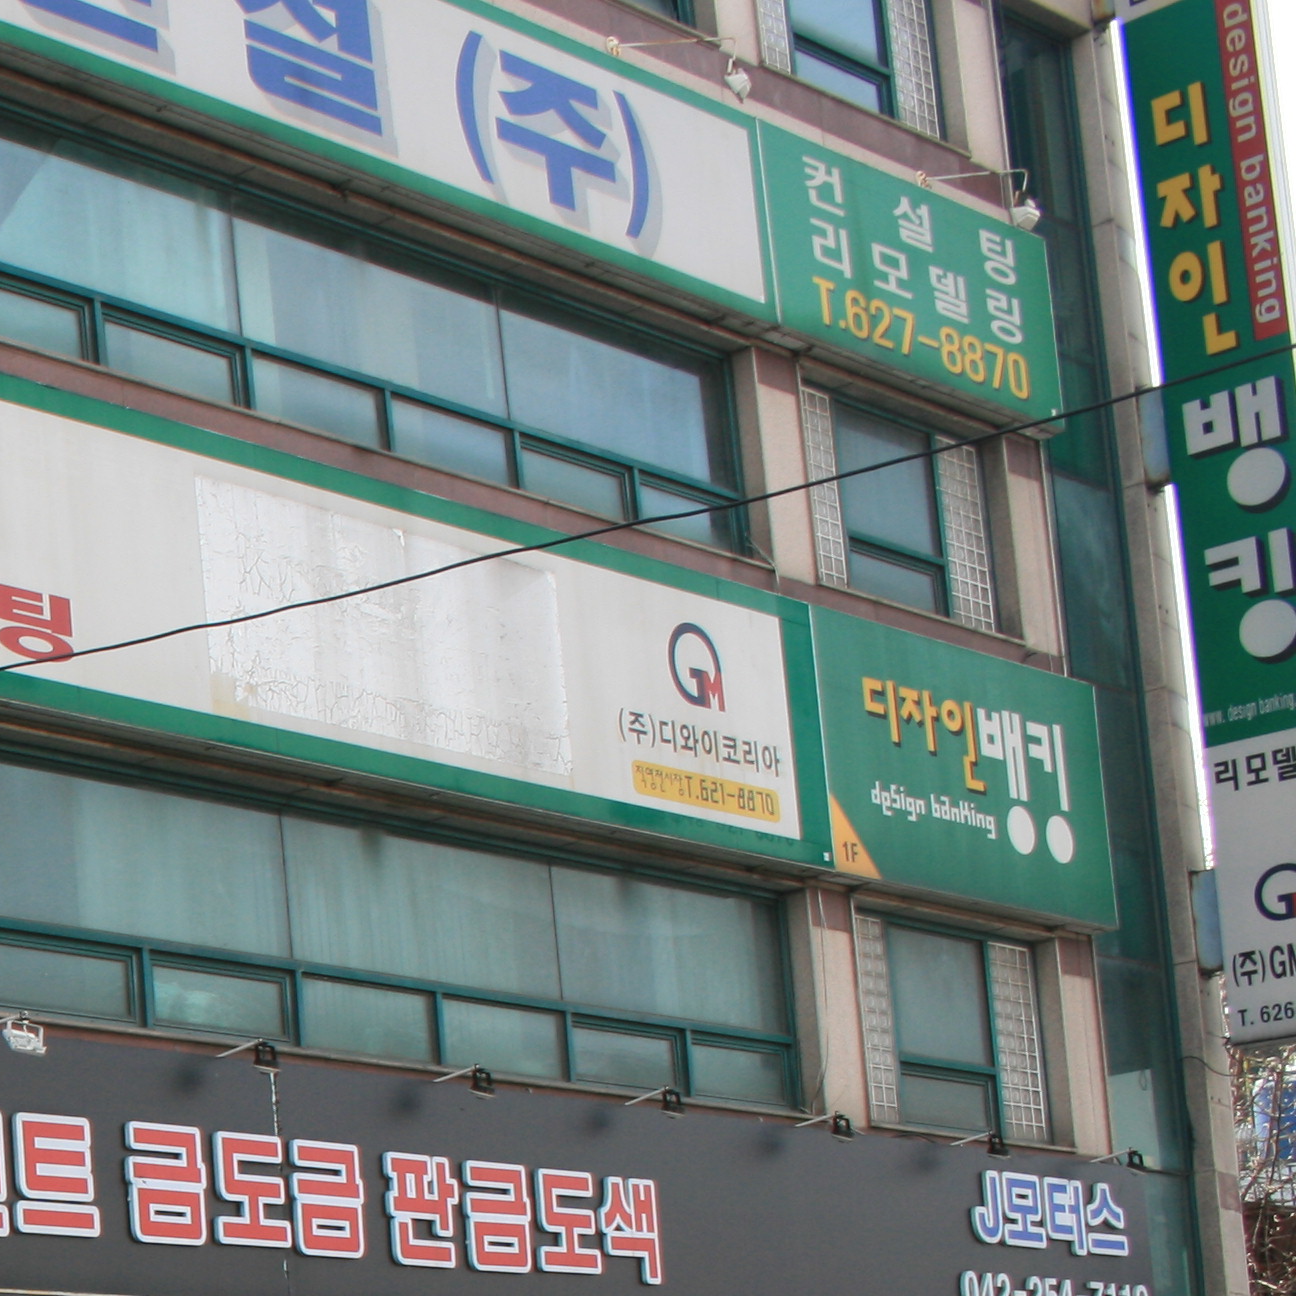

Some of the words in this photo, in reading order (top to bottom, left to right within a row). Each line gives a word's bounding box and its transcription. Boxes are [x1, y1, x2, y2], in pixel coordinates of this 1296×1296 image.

[802, 155, 1017, 286] 컨설팅
[1223, 2, 1257, 142] design
[1240, 154, 1282, 323] banking
[810, 217, 1024, 345] 리모델링
[123, 1119, 366, 1260] 금도금
[382, 1149, 663, 1286] 판금도색
[971, 1168, 1129, 1258] J모터스
